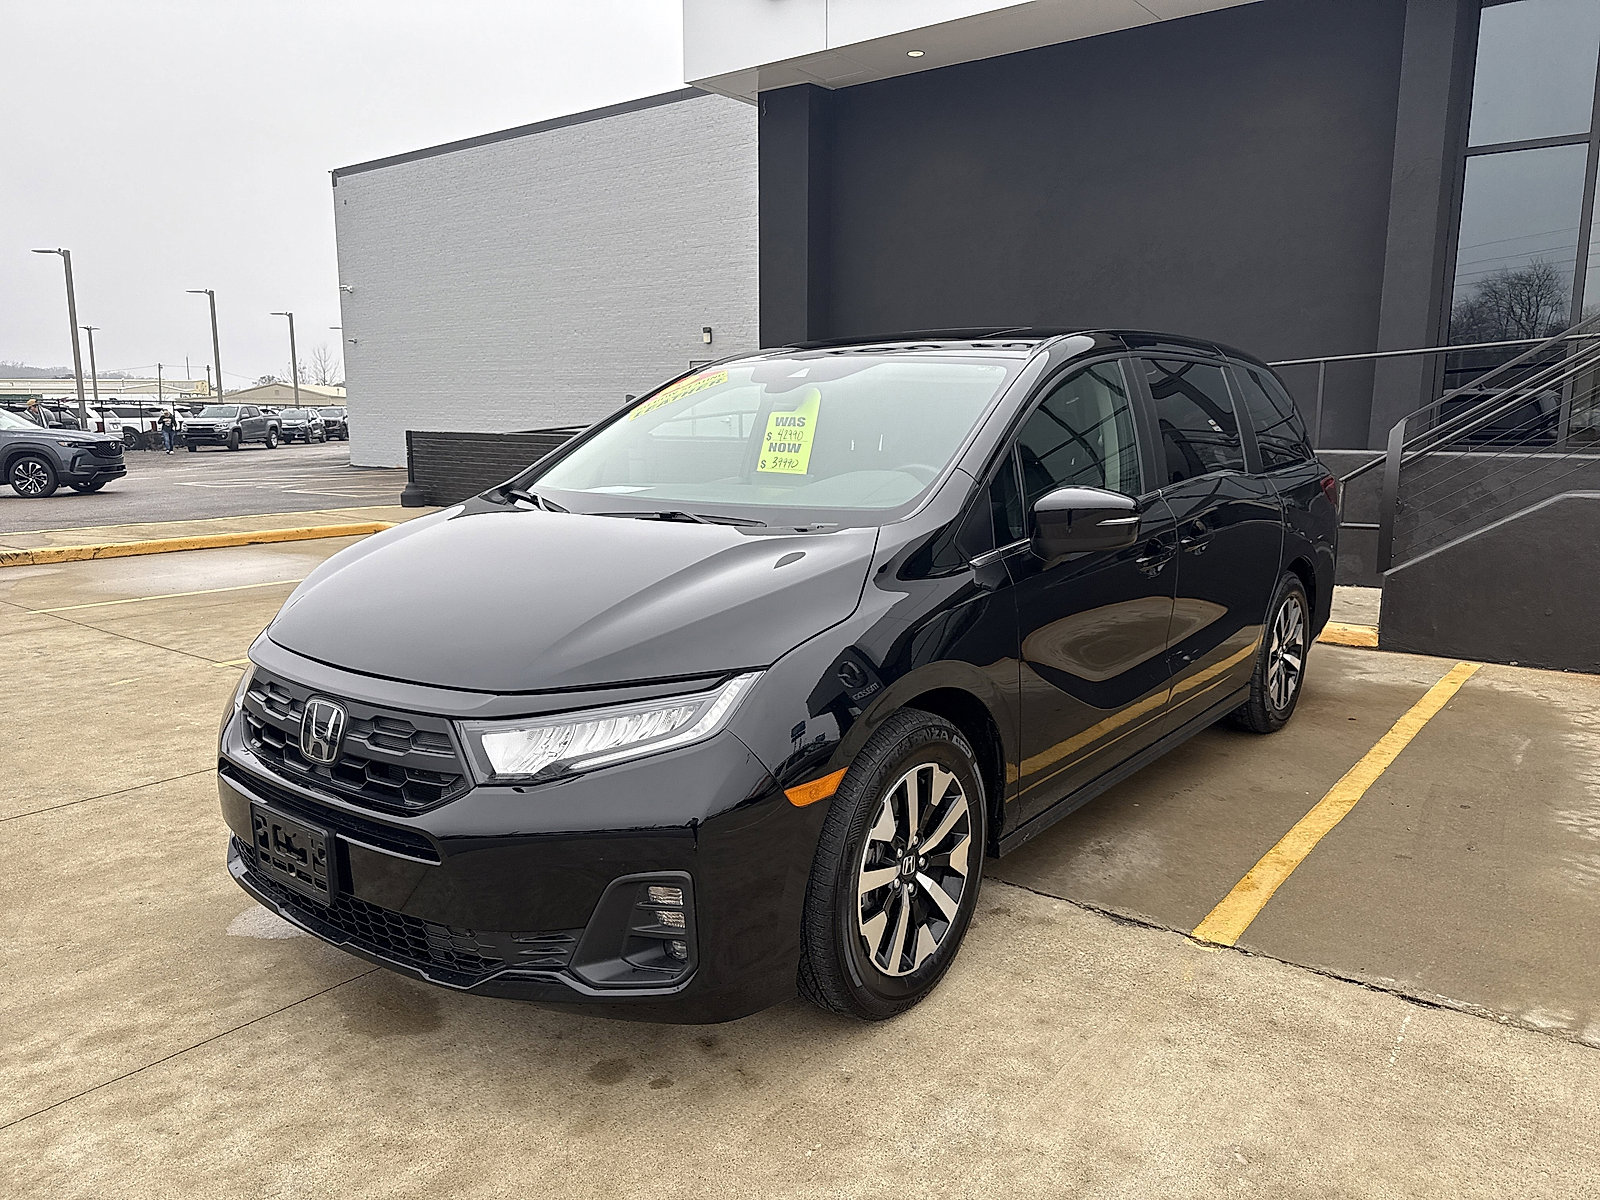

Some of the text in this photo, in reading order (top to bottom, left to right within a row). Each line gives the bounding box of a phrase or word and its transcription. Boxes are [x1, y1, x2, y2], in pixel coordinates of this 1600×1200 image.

[775, 416, 806, 427] WAS
[766, 428, 804, 441] $ 42990
[768, 442, 802, 453] NOW
[760, 456, 799, 469] $ 39990
